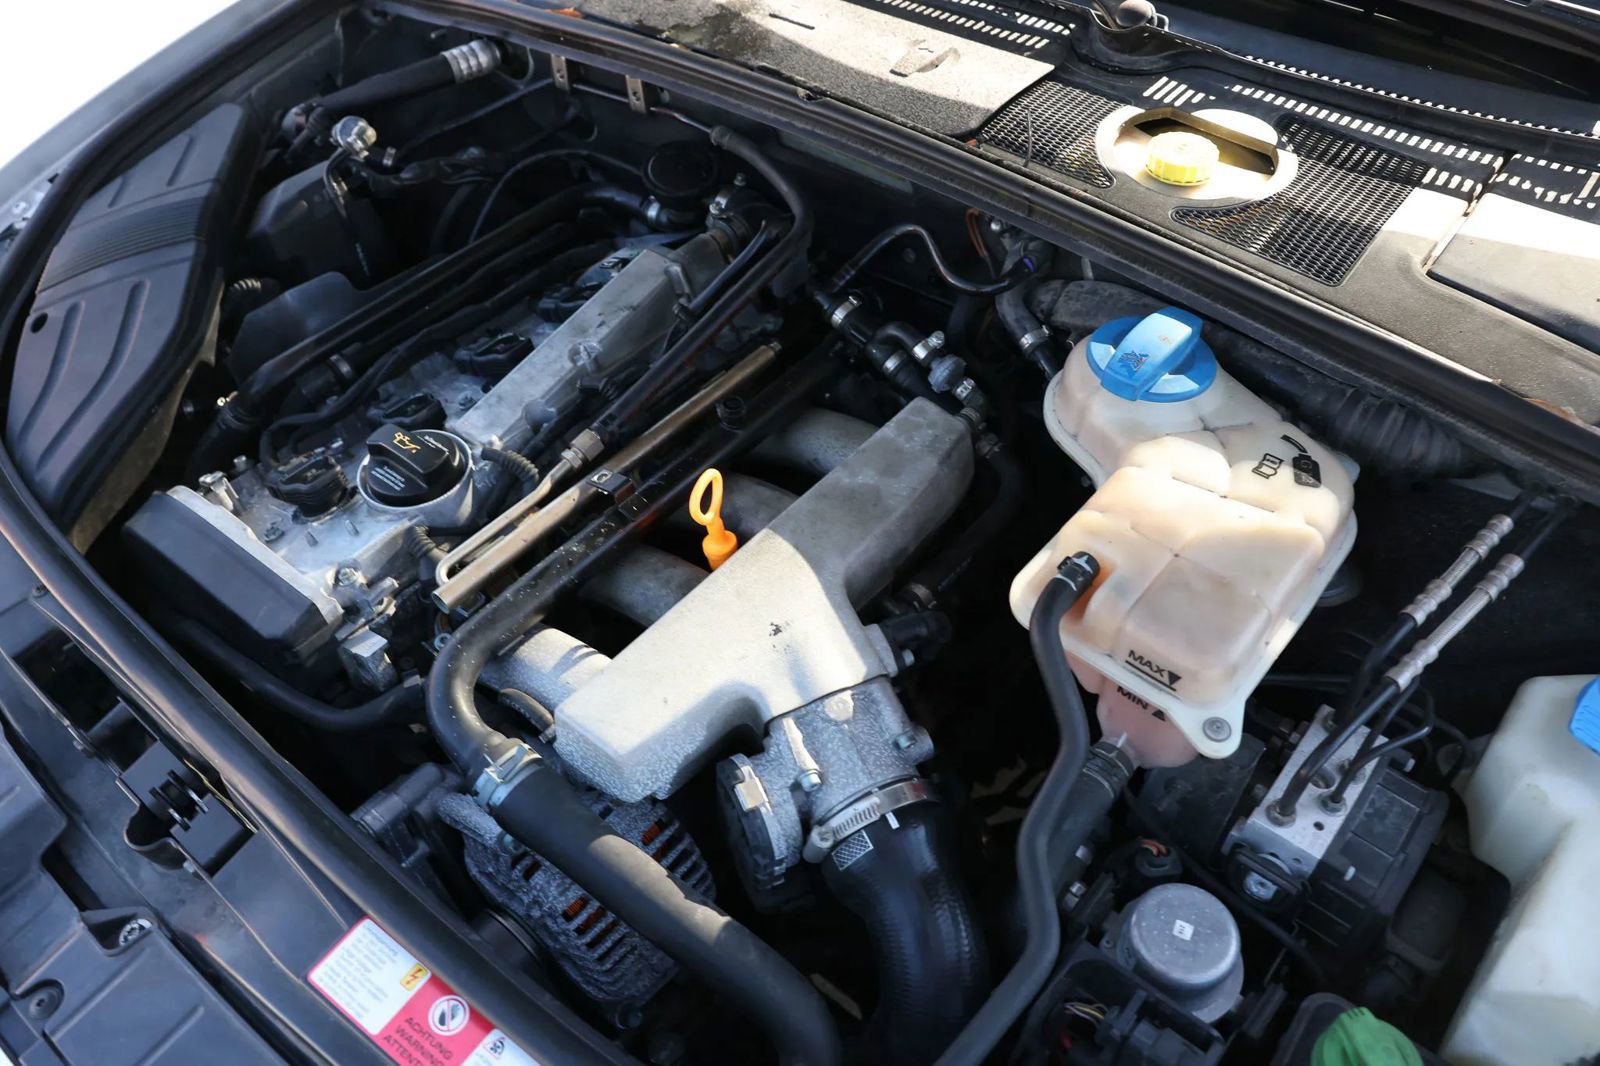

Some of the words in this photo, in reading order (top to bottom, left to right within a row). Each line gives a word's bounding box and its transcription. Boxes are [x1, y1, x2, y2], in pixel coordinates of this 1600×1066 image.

[1128, 650, 1166, 677] MAX
[1117, 686, 1149, 710] MIN
[404, 1017, 453, 1060] ACHTUNG
